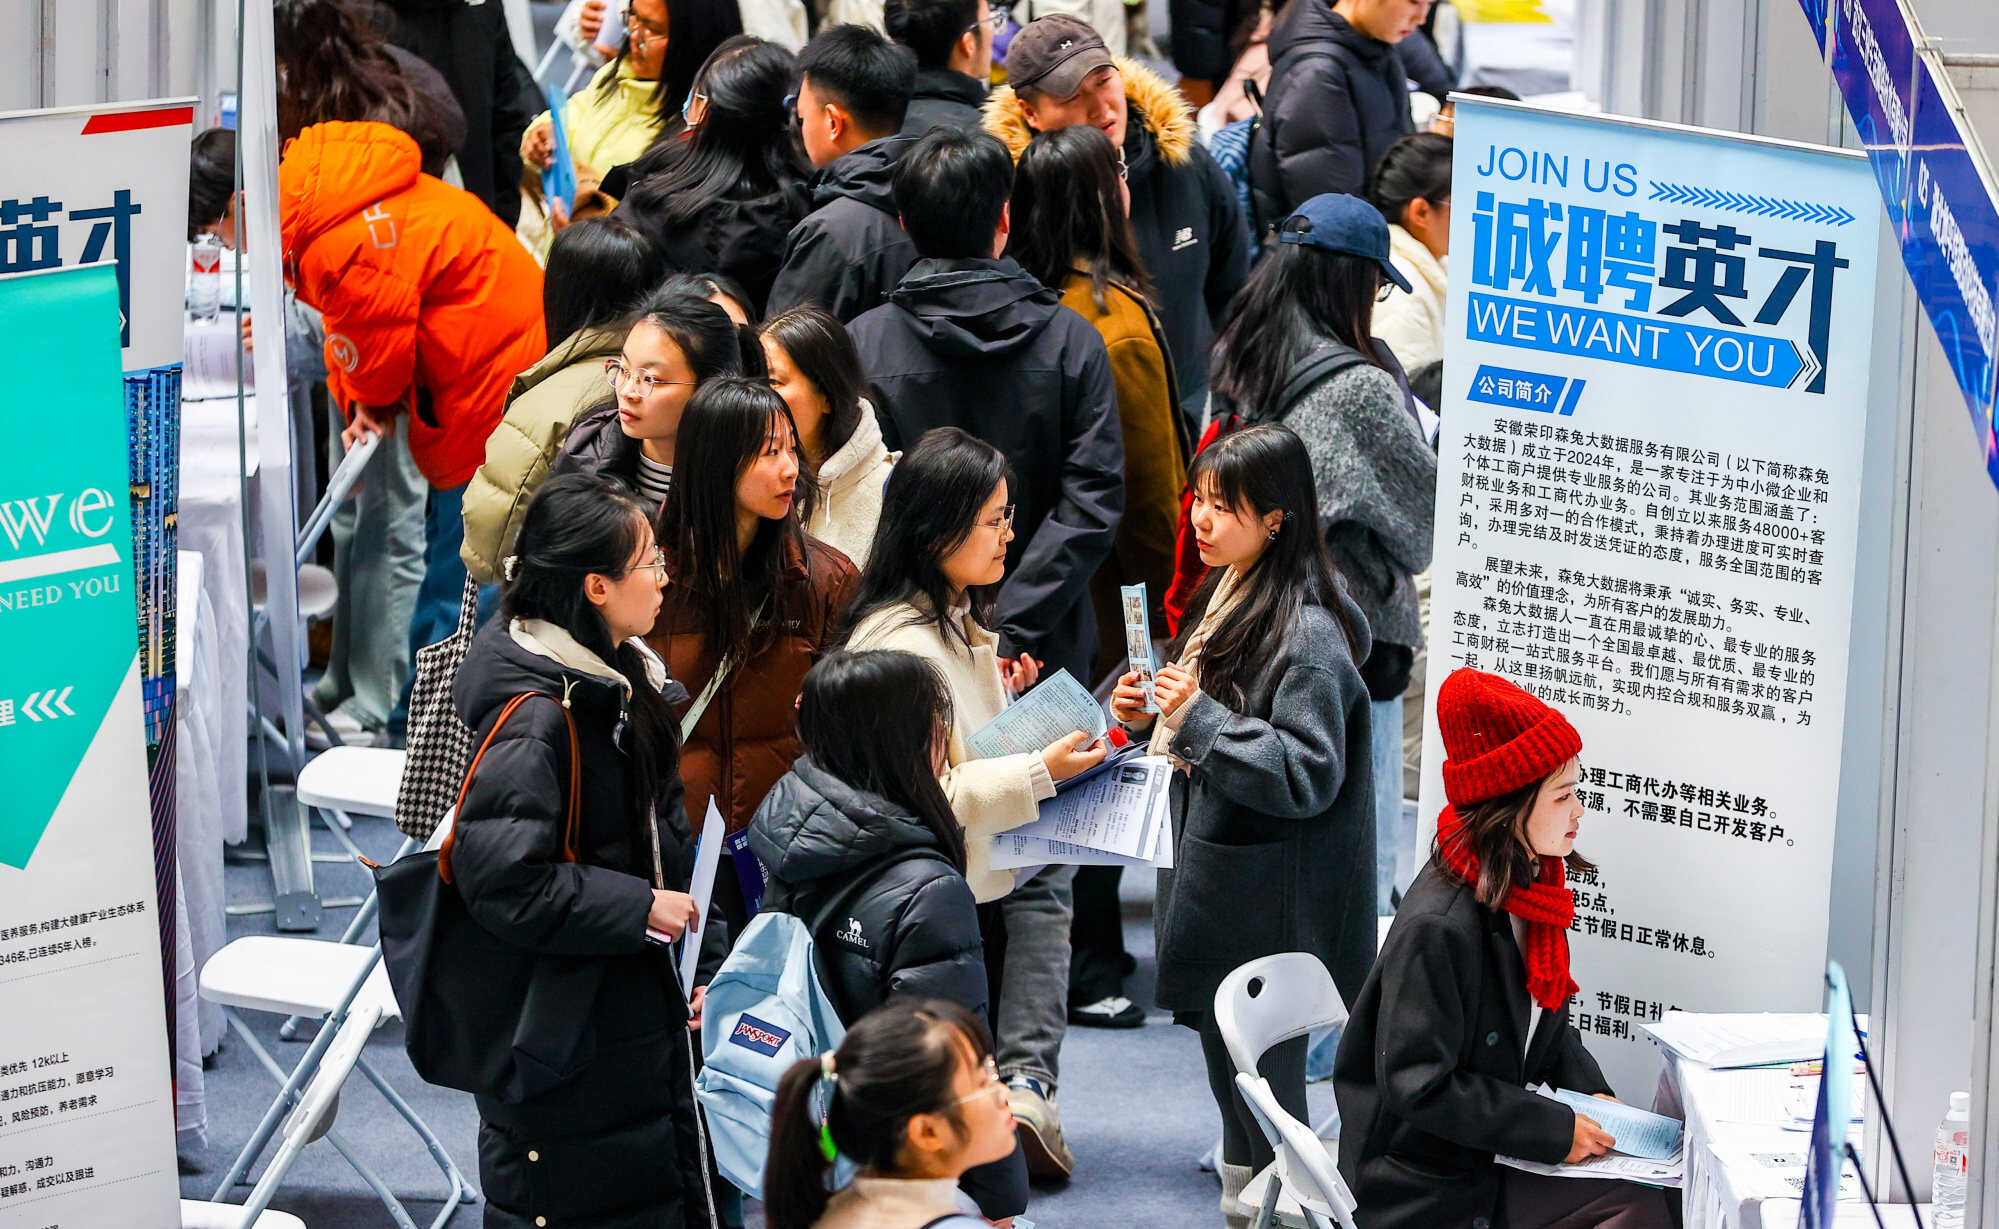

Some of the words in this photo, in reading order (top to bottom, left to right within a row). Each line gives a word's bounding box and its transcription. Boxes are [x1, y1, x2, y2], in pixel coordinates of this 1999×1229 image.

[1477, 145, 1568, 188] JOIN
[1583, 160, 1638, 197] US
[1471, 191, 1850, 394] 诚聘英才
[1472, 299, 1537, 342] WE
[1546, 310, 1670, 361] WANT
[1685, 331, 1775, 377] YOU
[1478, 374, 1553, 406] 公司简介
[68, 574, 120, 600] YOU
[836, 930, 870, 948] CAMEL
